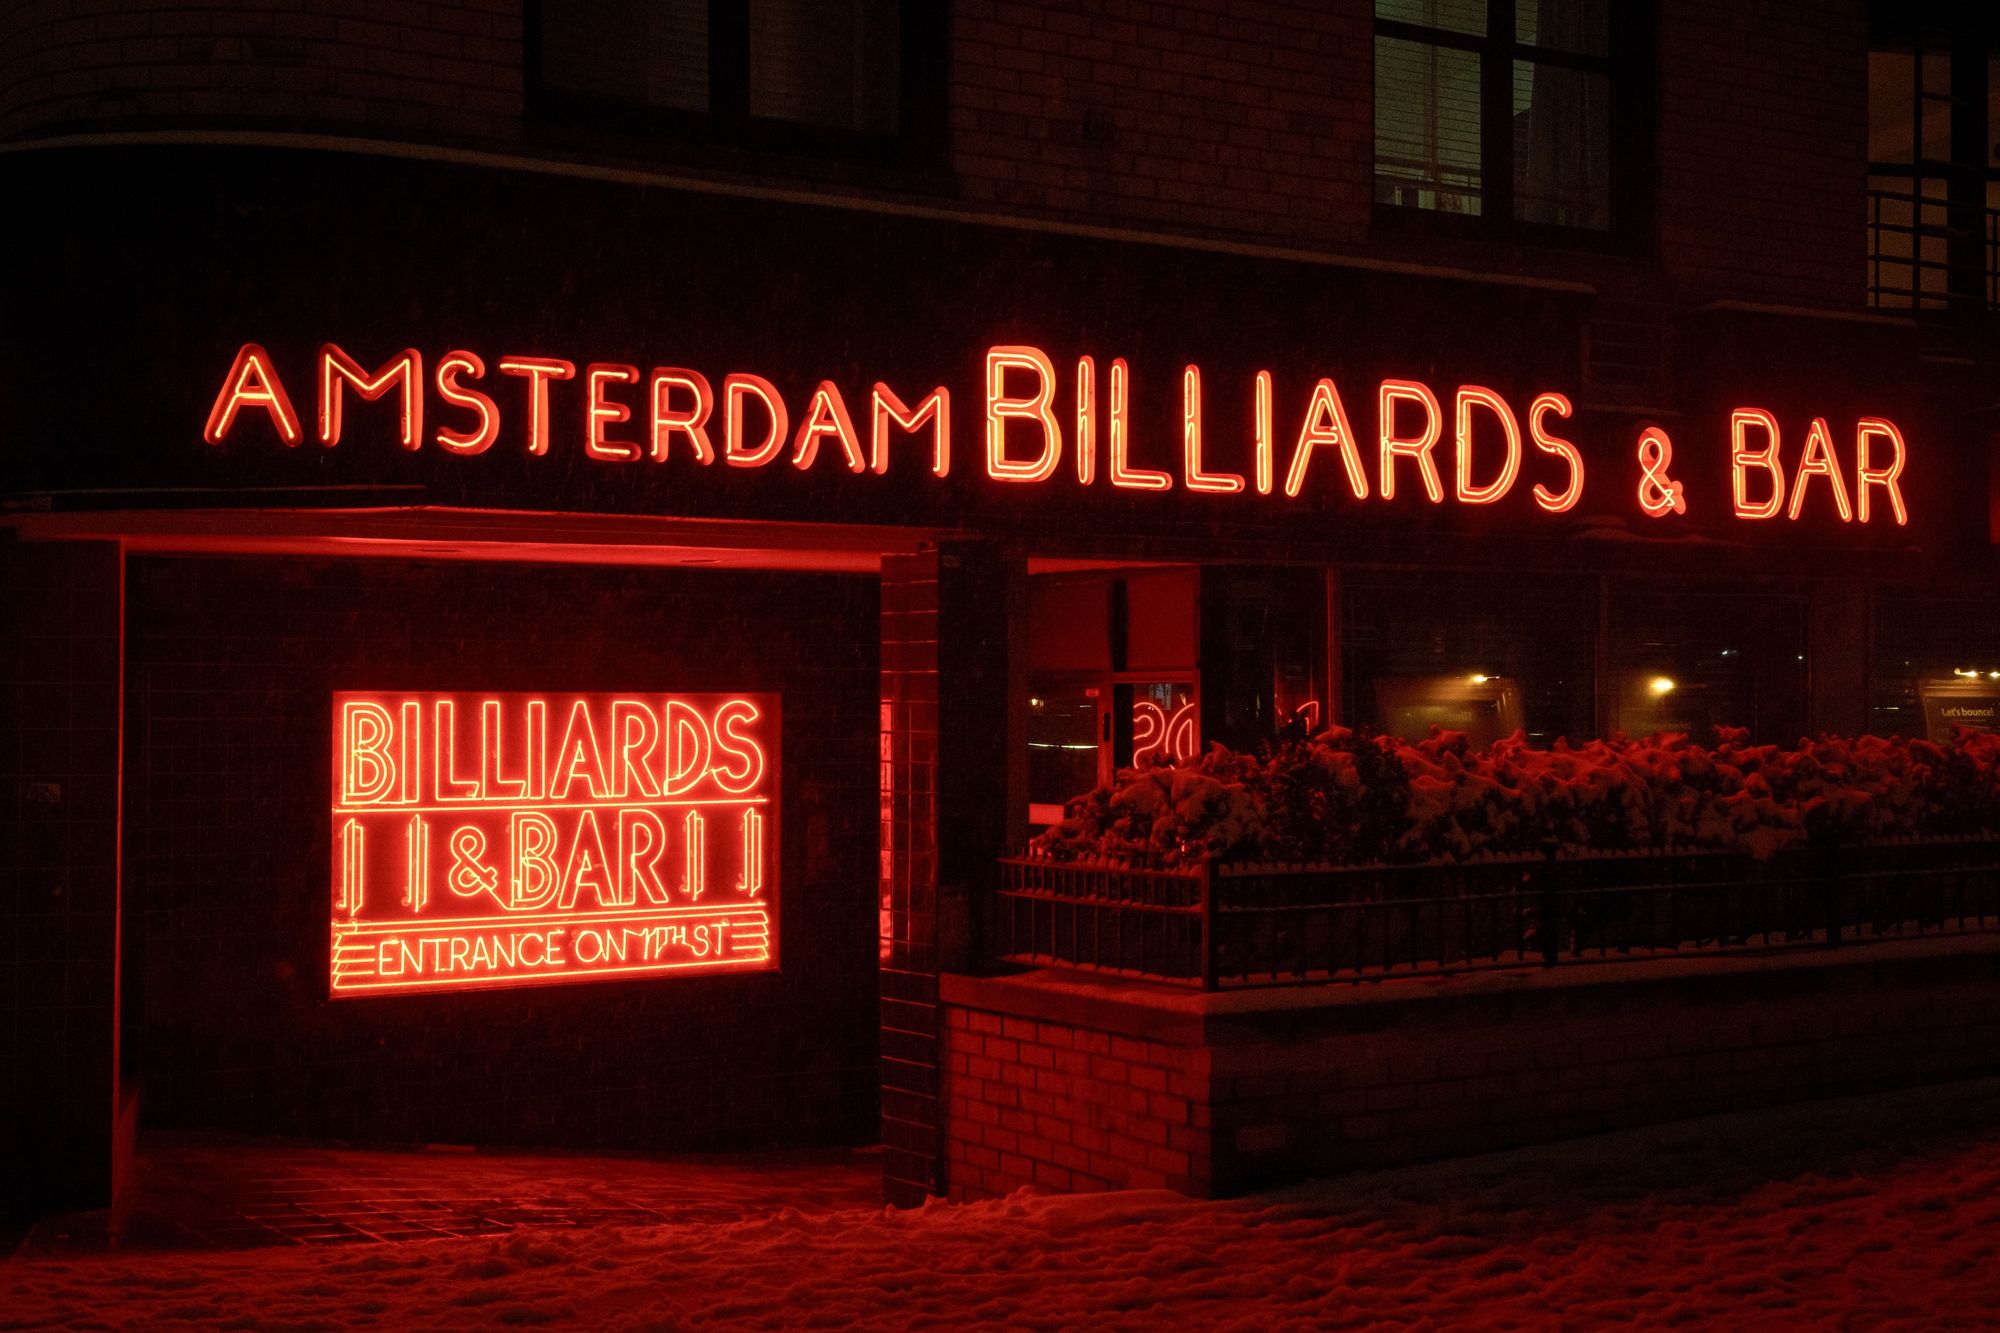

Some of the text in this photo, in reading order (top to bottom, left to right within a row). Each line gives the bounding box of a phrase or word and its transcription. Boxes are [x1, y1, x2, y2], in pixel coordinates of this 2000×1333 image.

[203, 343, 1908, 525] AMSTERDAM BILLIARDS & BAR
[341, 700, 764, 806] BILLIARDS
[1941, 706, 1995, 717] Let's bounce!
[448, 808, 670, 911] & BAR
[378, 929, 566, 976] ENTRANCE
[574, 929, 628, 963] ON
[693, 923, 731, 957] ST
